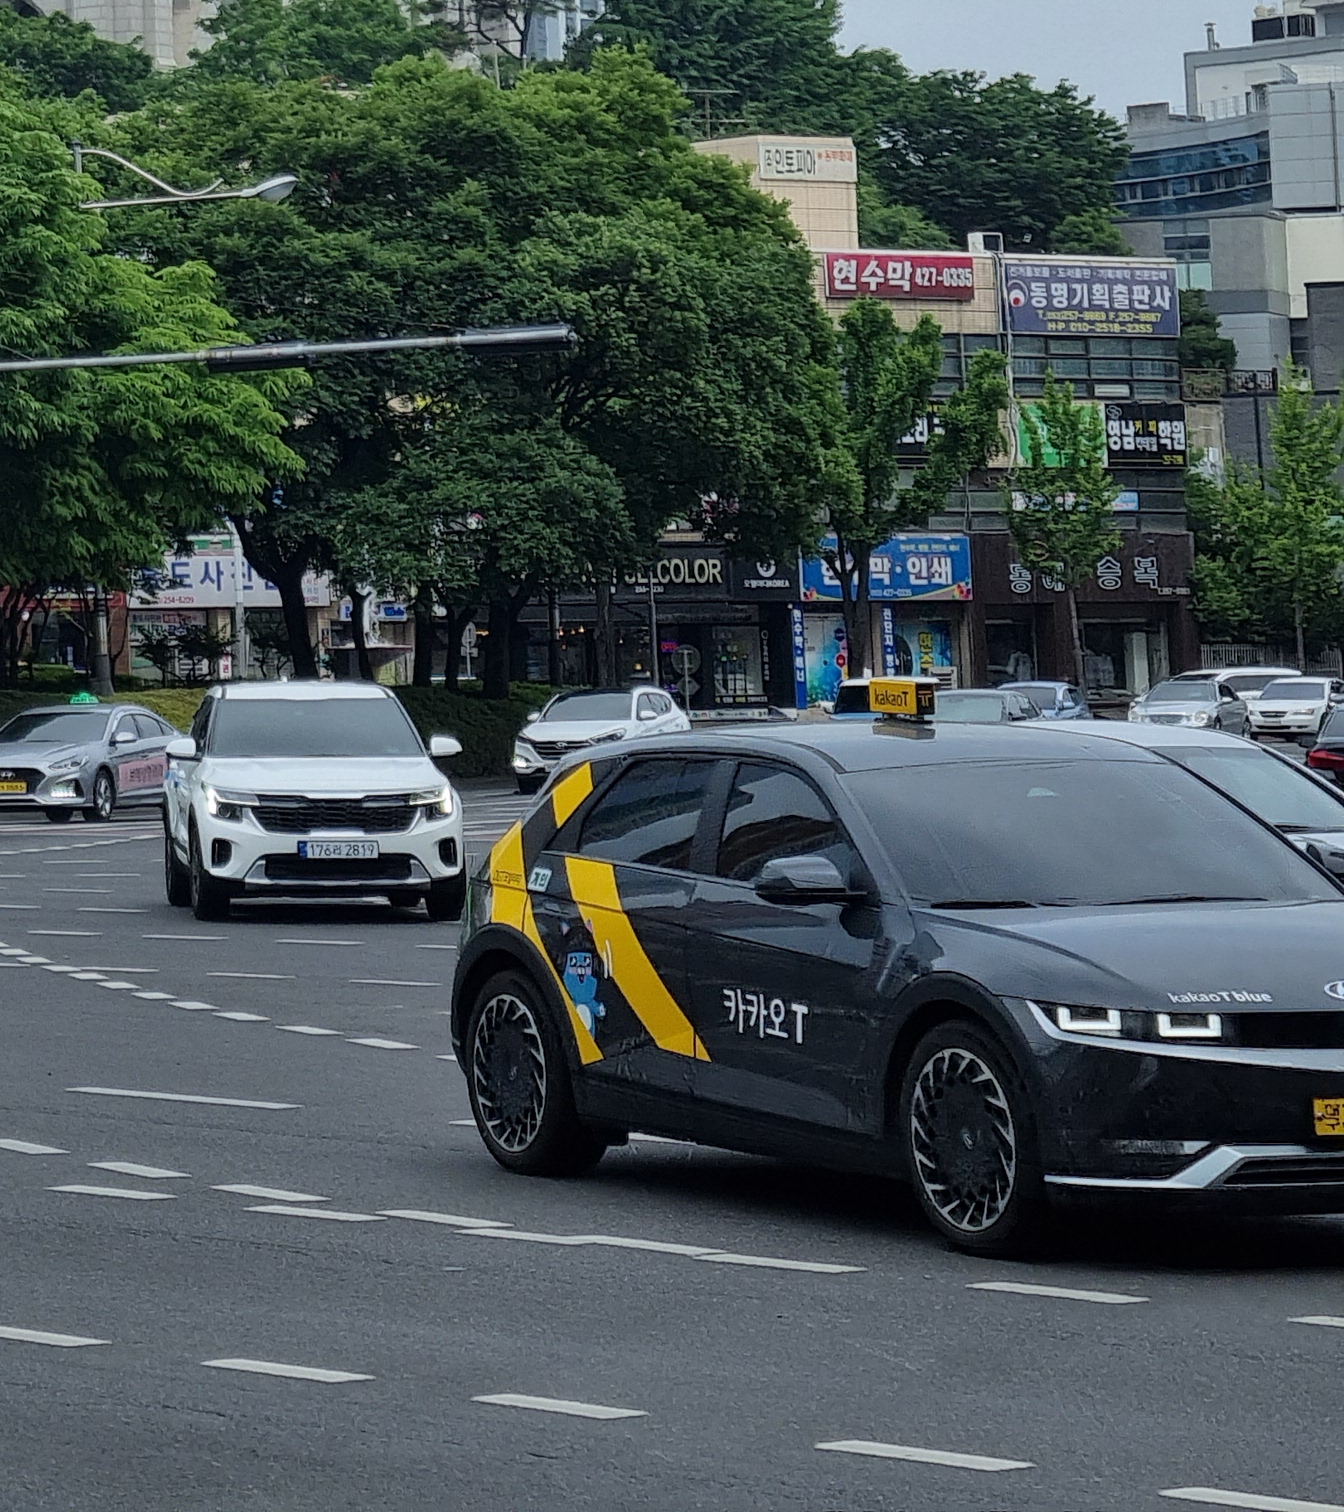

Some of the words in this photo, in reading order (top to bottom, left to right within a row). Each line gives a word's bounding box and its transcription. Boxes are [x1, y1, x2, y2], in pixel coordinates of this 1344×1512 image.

[833, 258, 912, 292] 현수막
[915, 266, 973, 288] 427-0335
[1030, 282, 1172, 310] 동명기획출판사
[1108, 420, 1135, 450] 영남
[1158, 420, 1186, 450] 학원
[164, 596, 194, 604] 254-6209
[918, 631, 933, 669] 현수
[1233, 990, 1273, 1003] blue
